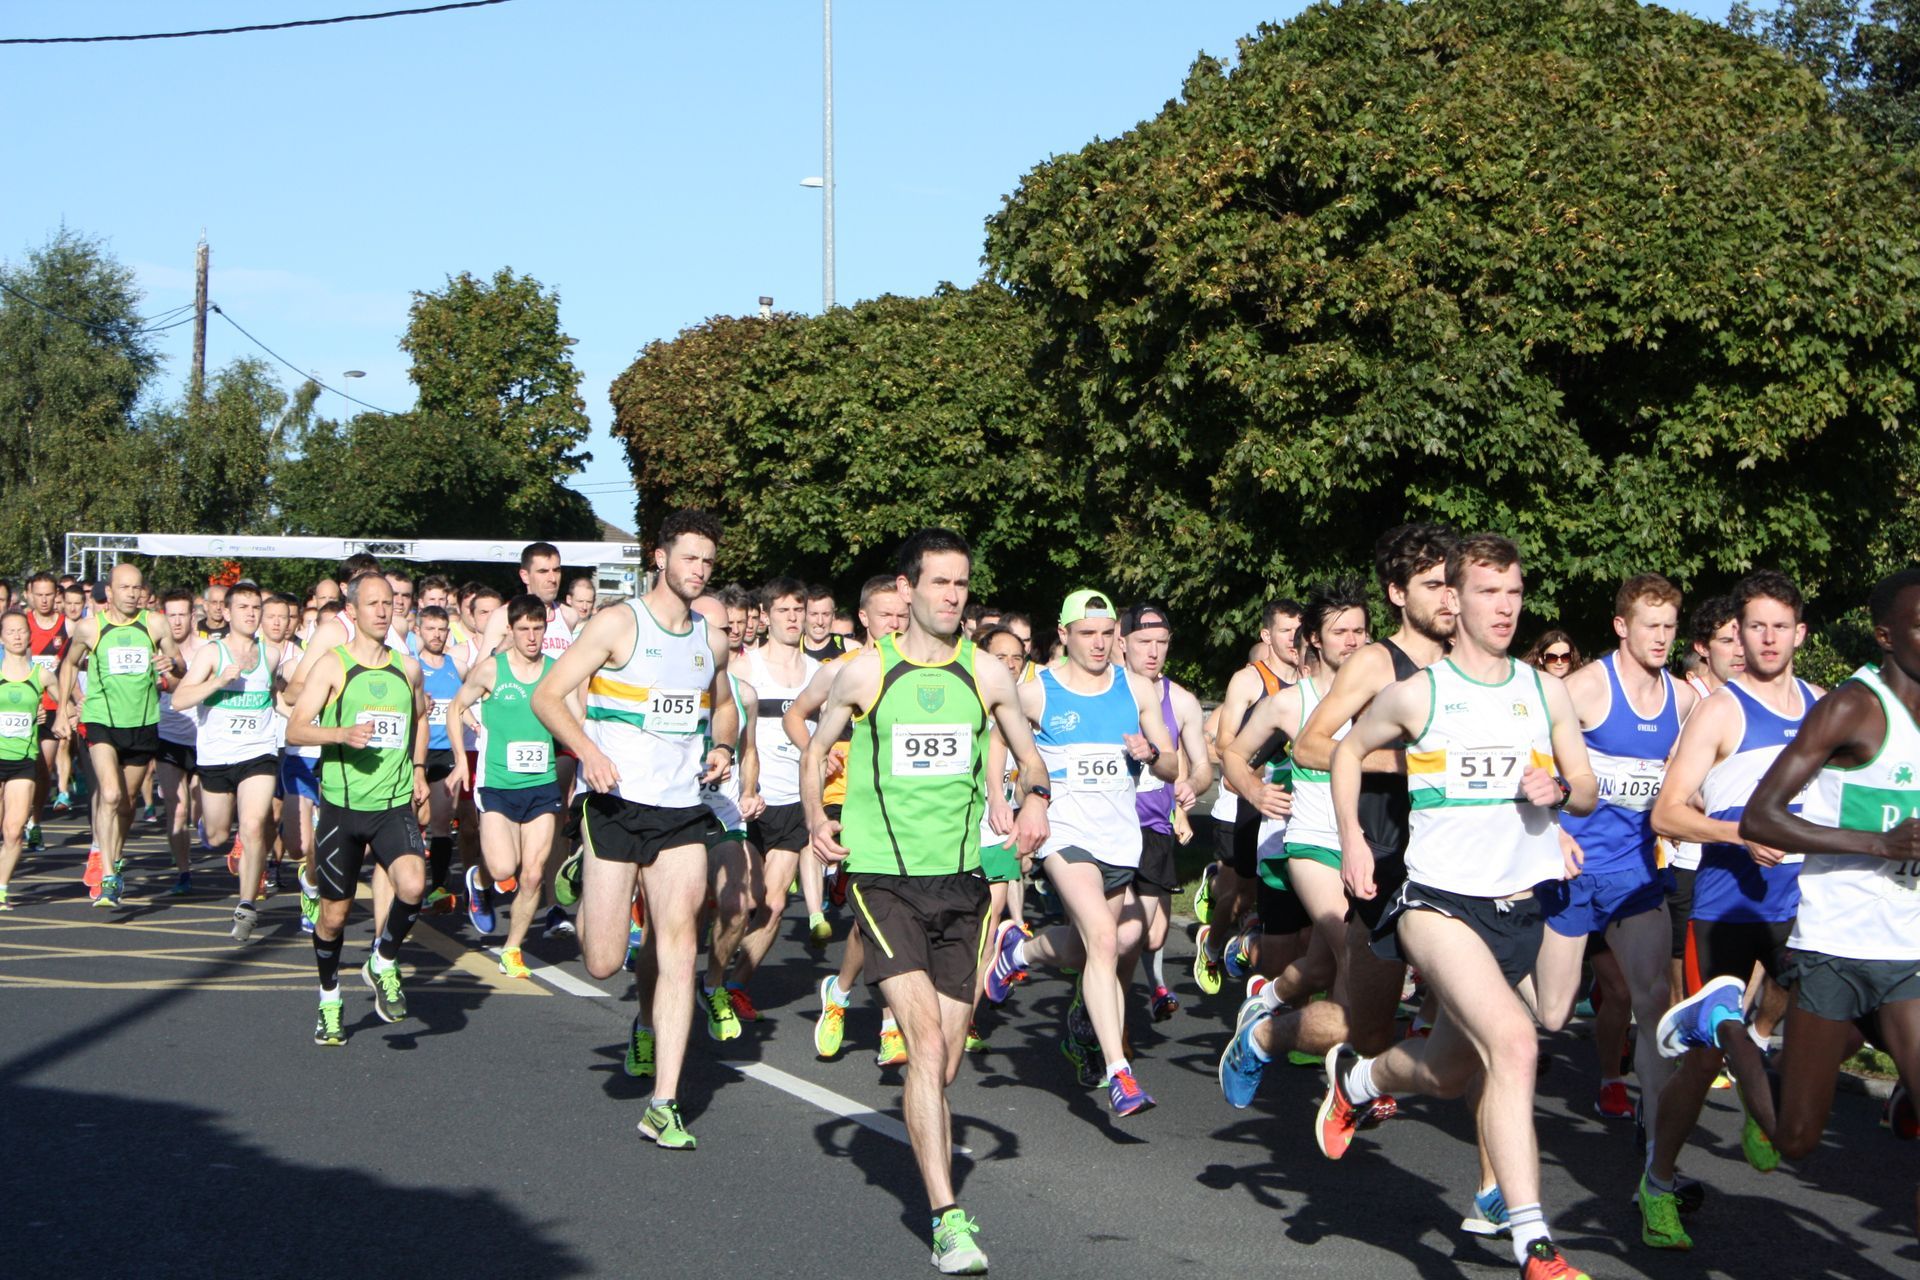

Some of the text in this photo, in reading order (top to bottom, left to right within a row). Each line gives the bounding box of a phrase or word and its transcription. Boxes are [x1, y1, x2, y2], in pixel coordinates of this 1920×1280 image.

[116, 653, 142, 664] 182
[645, 648, 662, 656] KC
[652, 698, 694, 714] 1055
[1445, 702, 1468, 712] KC
[230, 718, 257, 730] 778
[378, 721, 399, 736] 81
[905, 737, 957, 758] 983
[515, 749, 543, 762] 323
[1077, 760, 1118, 776] 566
[1460, 756, 1517, 777] 517
[1619, 781, 1660, 797] 1036
